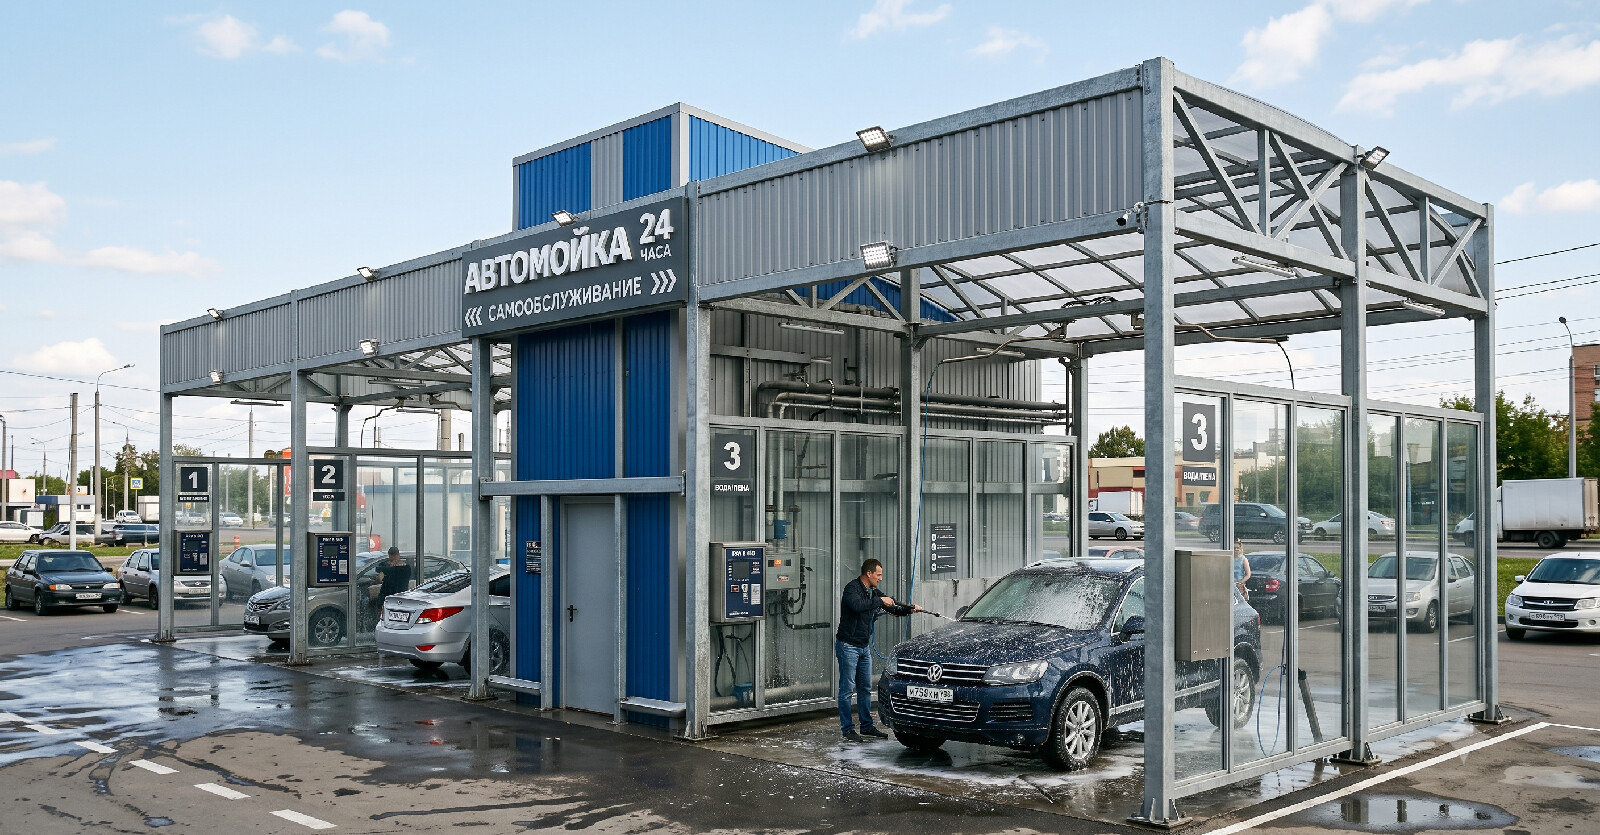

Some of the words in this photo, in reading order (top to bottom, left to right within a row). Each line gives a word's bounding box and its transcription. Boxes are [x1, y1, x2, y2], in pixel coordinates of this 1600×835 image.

[639, 208, 675, 246] 24
[464, 226, 632, 295] АВТОМОЙКА
[640, 244, 672, 262] ЧАСА
[488, 276, 642, 322] САМООБСЛУЖИВАНИЕ
[1191, 413, 1208, 451] 3
[723, 441, 741, 470] 3
[188, 471, 198, 489] 1
[321, 464, 336, 484] 2
